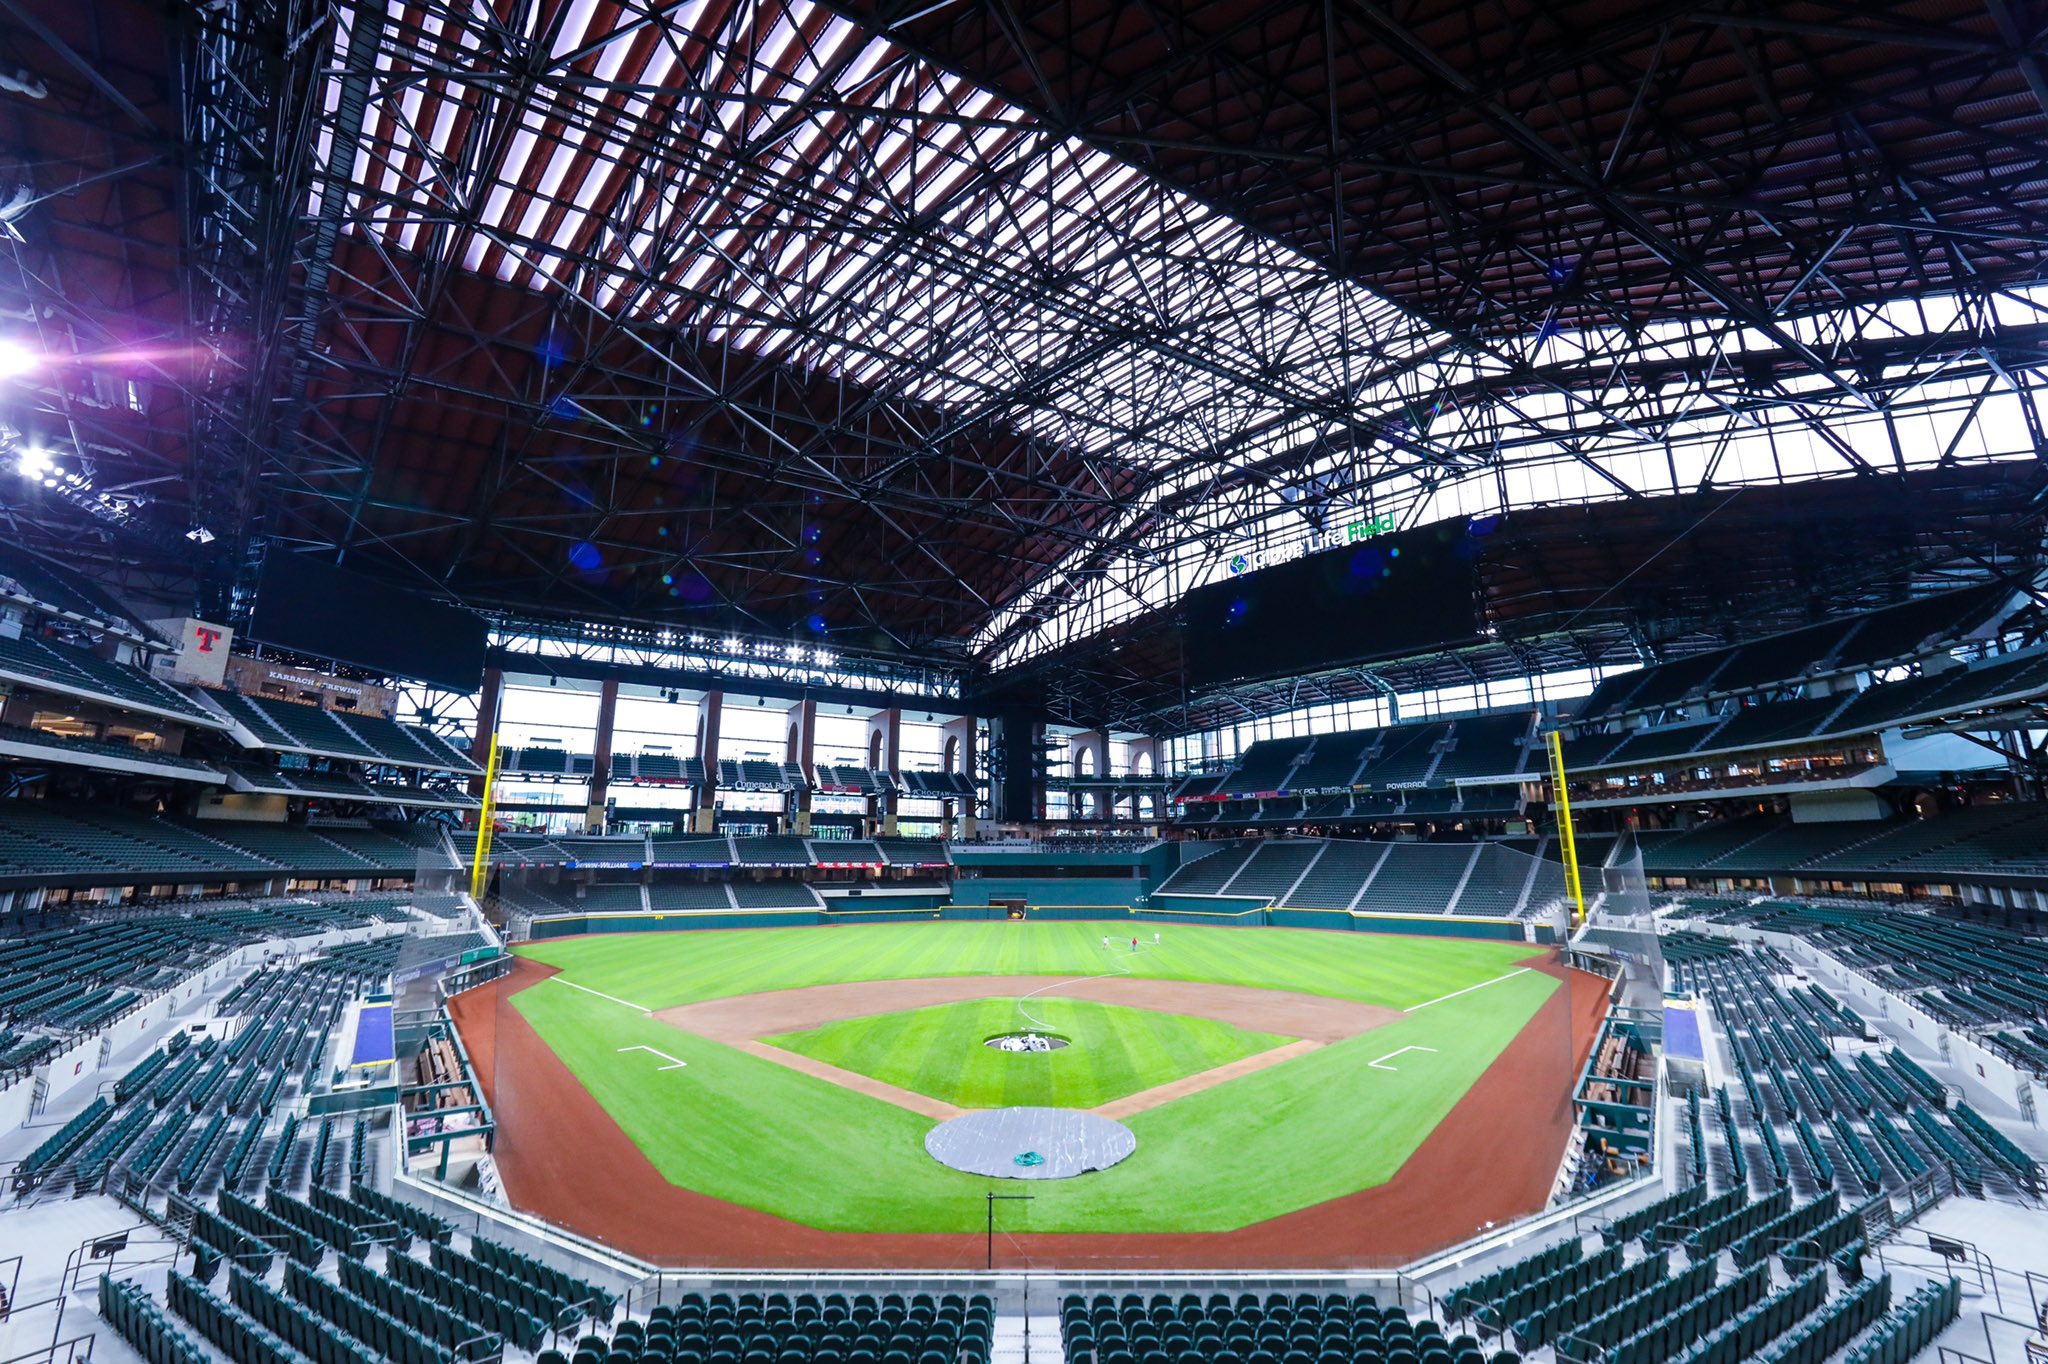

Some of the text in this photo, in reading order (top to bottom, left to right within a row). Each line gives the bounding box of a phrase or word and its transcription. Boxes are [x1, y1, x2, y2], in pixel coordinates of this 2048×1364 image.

[1308, 530, 1342, 552] Life
[1347, 511, 1394, 542] Field
[196, 626, 222, 653] T
[268, 671, 314, 686] KARBACH
[774, 782, 796, 791] Bank
[1386, 780, 1428, 790] POWERADE
